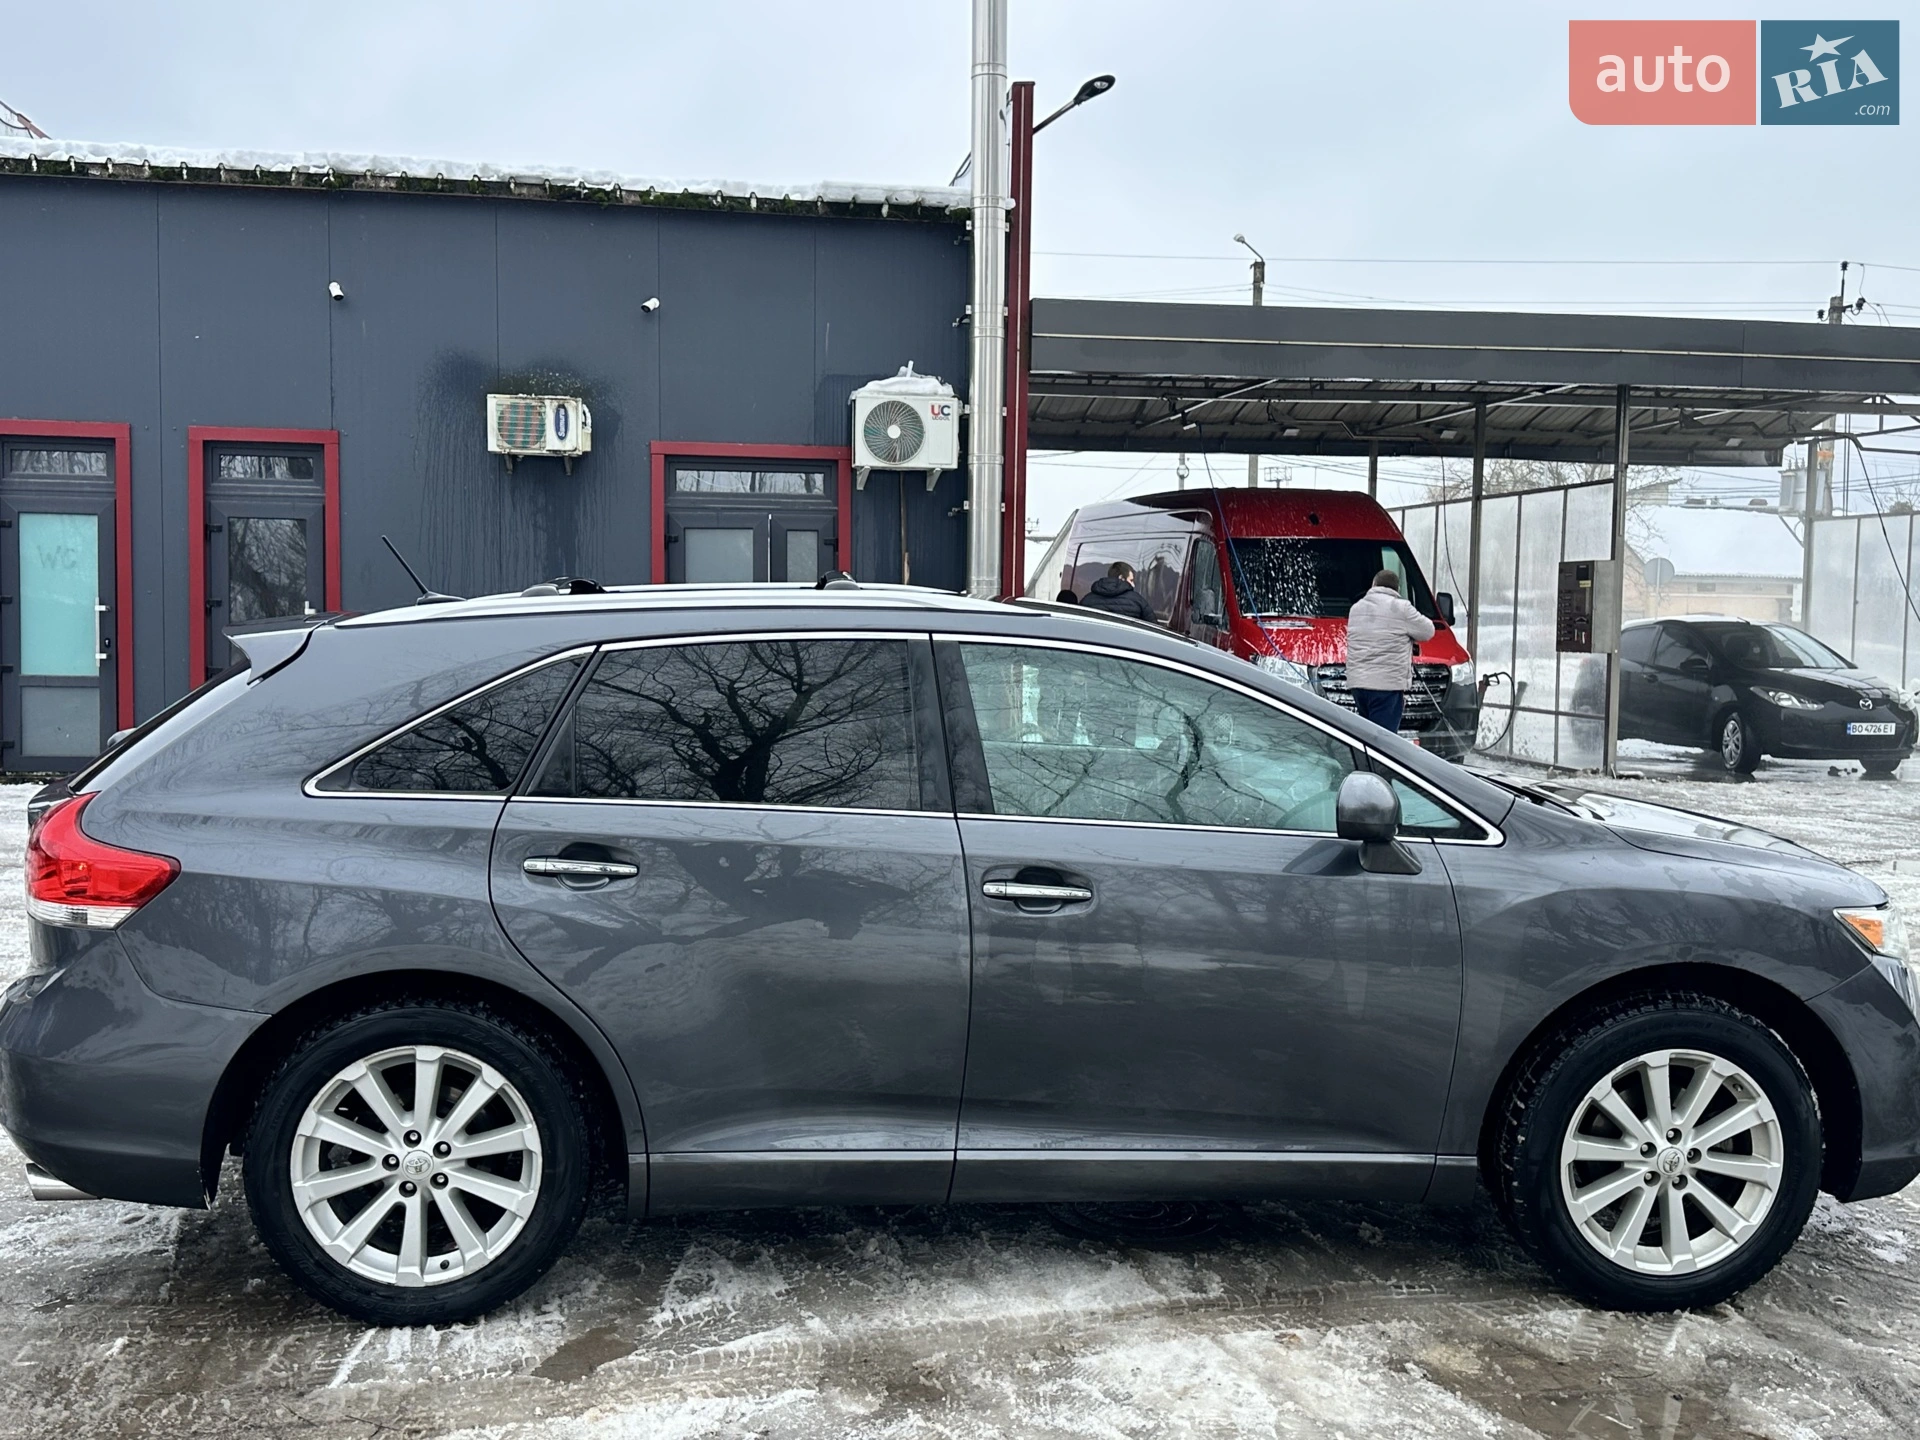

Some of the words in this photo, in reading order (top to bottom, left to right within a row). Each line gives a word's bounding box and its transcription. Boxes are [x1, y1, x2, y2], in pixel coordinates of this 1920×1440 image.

[931, 404, 951, 417] UC
[36, 545, 77, 570] WC
[1851, 724, 1864, 734] BO
[1864, 724, 1882, 734] 4726
